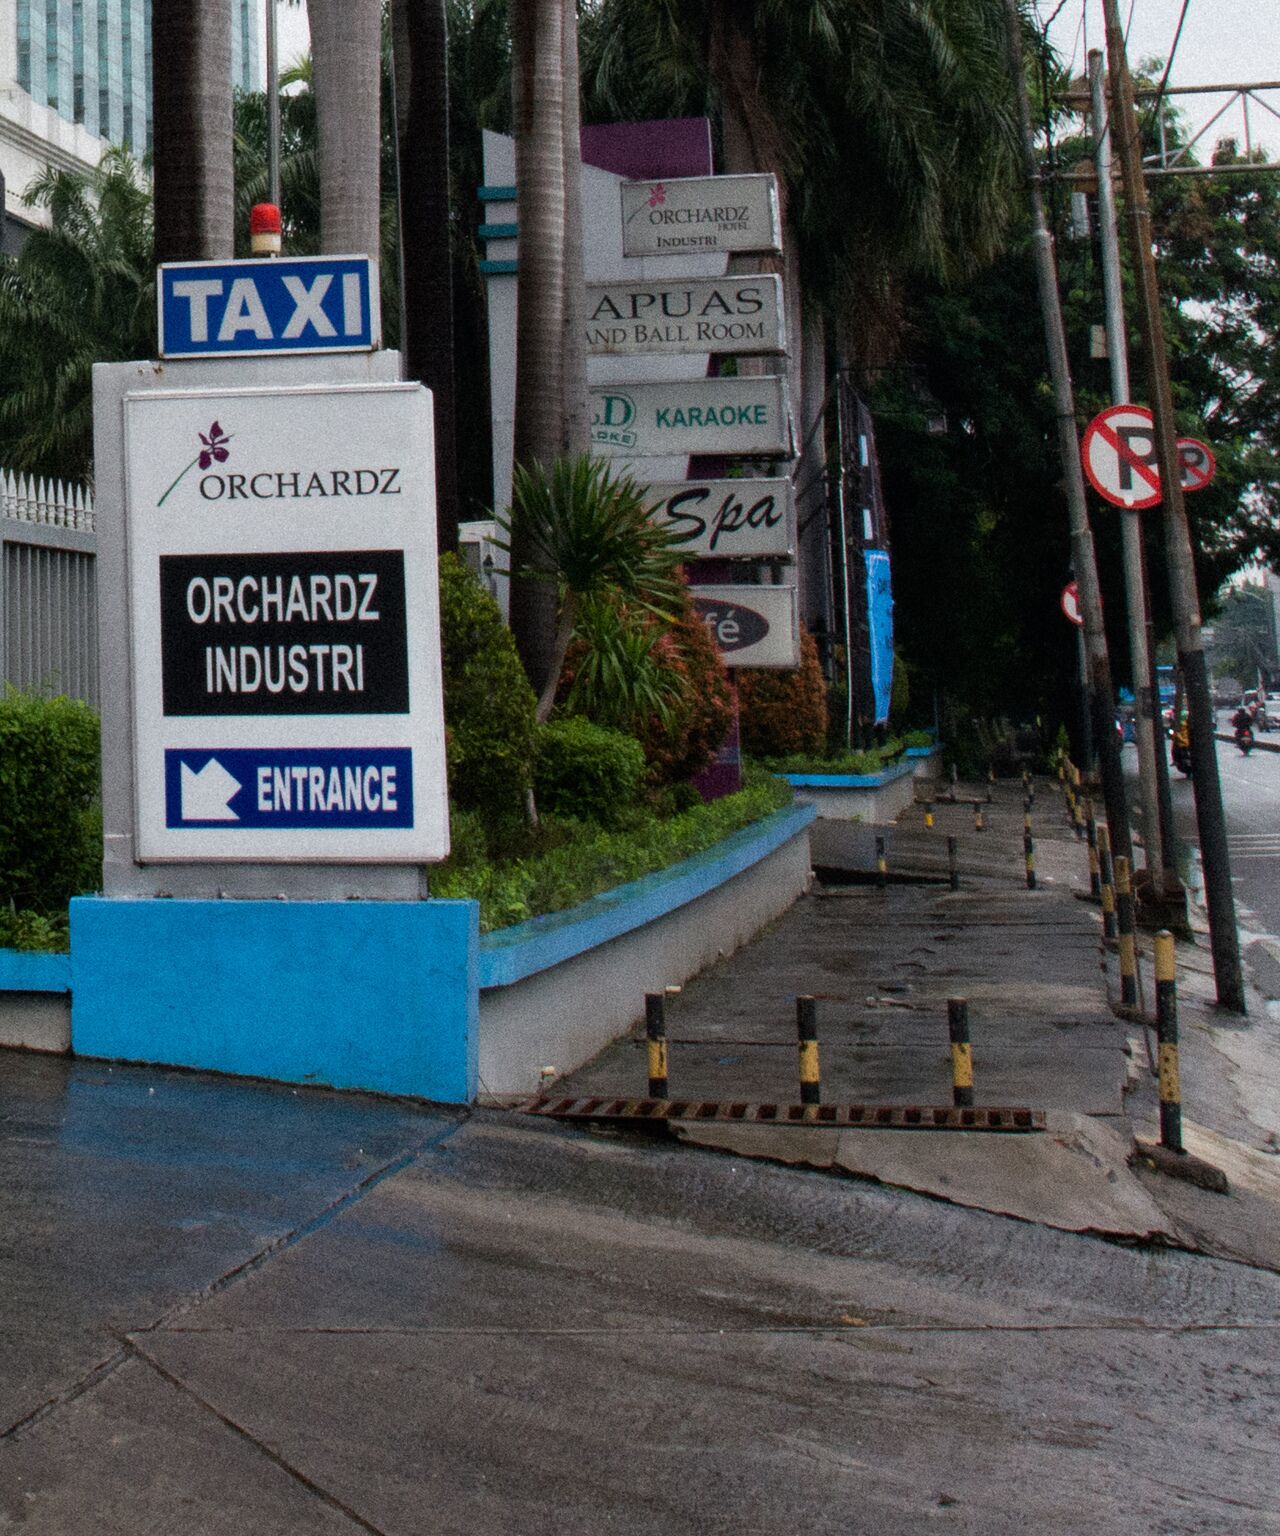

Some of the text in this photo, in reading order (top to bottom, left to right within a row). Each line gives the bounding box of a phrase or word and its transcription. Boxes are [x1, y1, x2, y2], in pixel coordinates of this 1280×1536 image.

[649, 206, 749, 225] ORCHARDZ
[657, 236, 718, 248] INDUSTRI
[172, 272, 362, 344] TAXI
[635, 324, 690, 343] BALL
[697, 321, 765, 340] ROOM
[656, 405, 768, 428] KARAOKE
[198, 468, 402, 501] ORCHARDZ
[664, 487, 783, 551] Spa
[186, 573, 380, 625] ORCHARDZ
[206, 644, 364, 694] INDUSTRI
[256, 766, 398, 813] ENTRANCE
